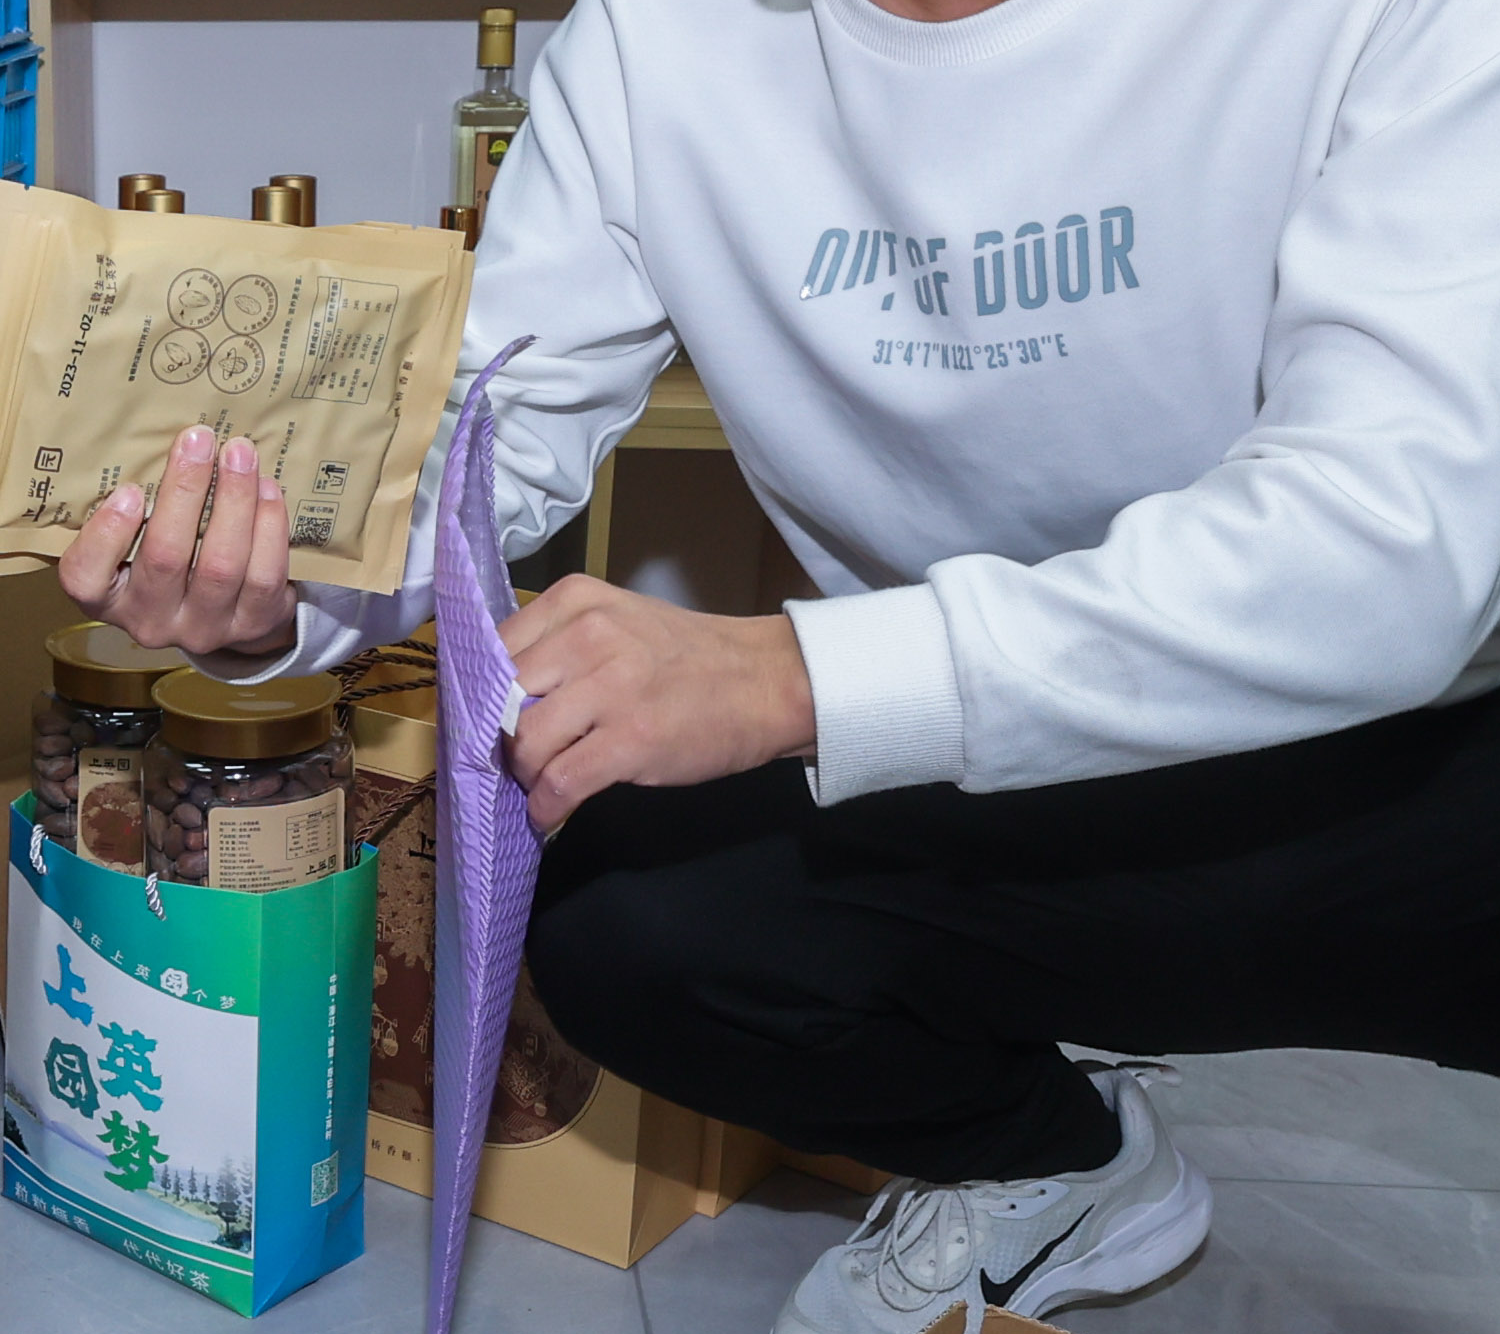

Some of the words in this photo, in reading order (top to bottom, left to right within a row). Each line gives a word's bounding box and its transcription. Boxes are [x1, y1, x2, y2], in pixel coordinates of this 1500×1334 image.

[973, 205, 1139, 317] DOOR
[58, 314, 94, 399] 2023-11-02
[123, 1239, 211, 1295] 代代好茶
